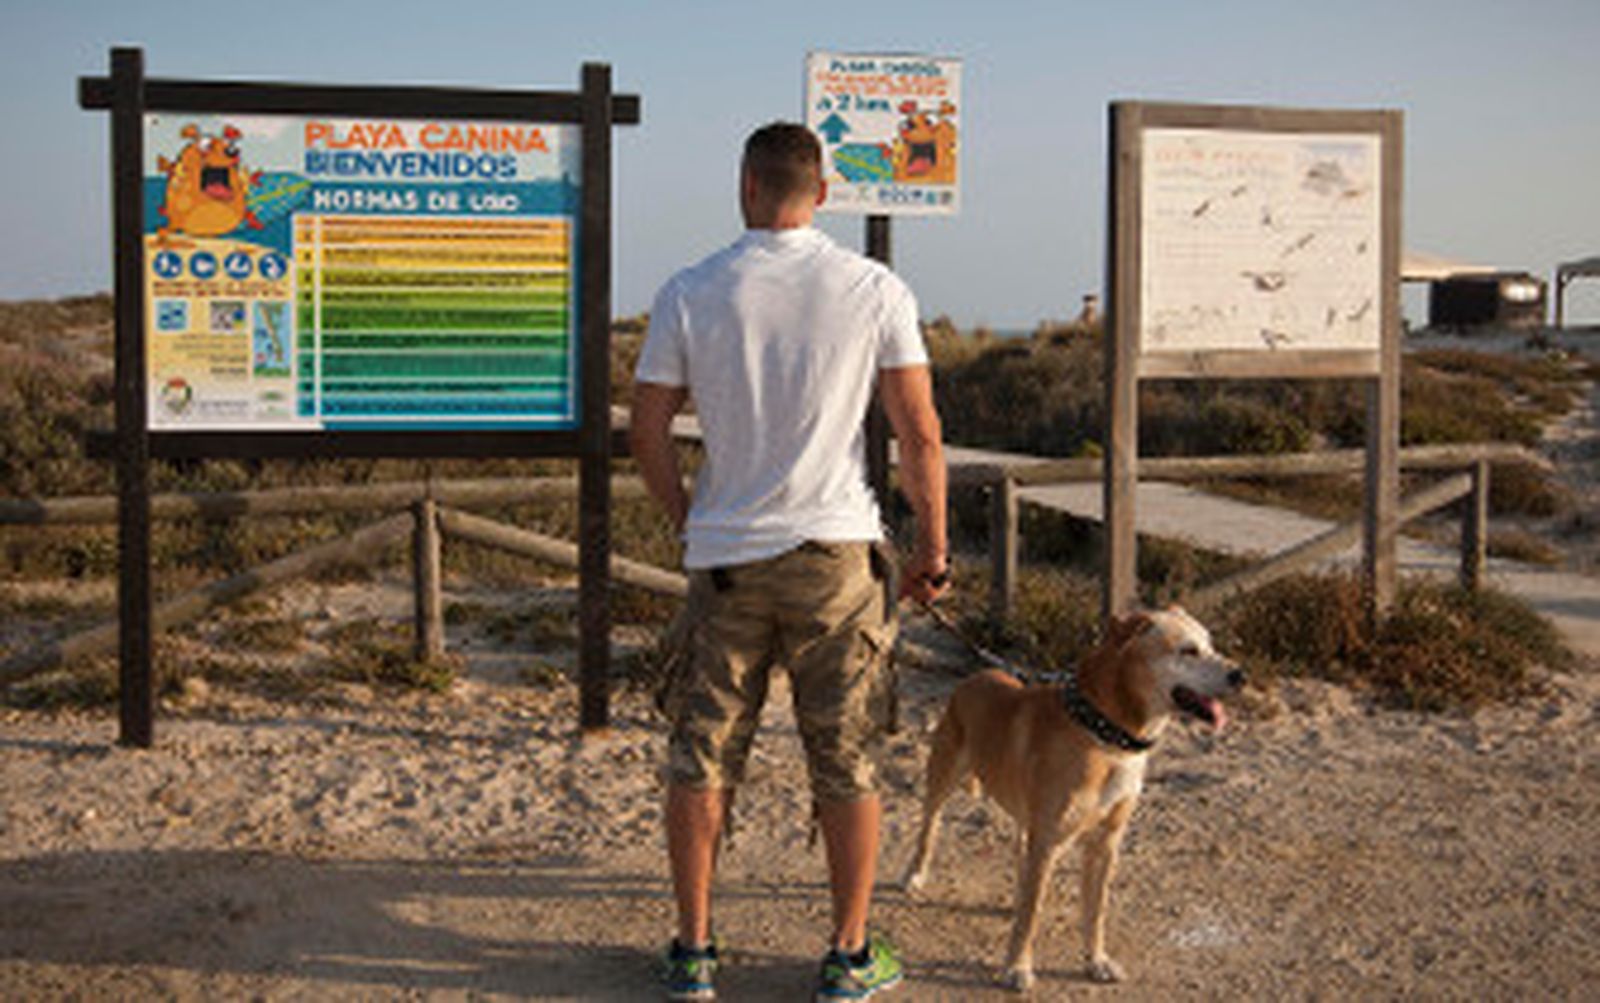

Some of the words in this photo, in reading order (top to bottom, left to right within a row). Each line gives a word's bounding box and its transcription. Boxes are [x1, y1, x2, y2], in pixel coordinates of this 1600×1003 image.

[305, 122, 406, 149] PLAYA
[419, 125, 549, 153] CANINA
[304, 153, 517, 177] BIENVENIDOS
[314, 191, 418, 211] NORMAS
[428, 193, 459, 211] DE
